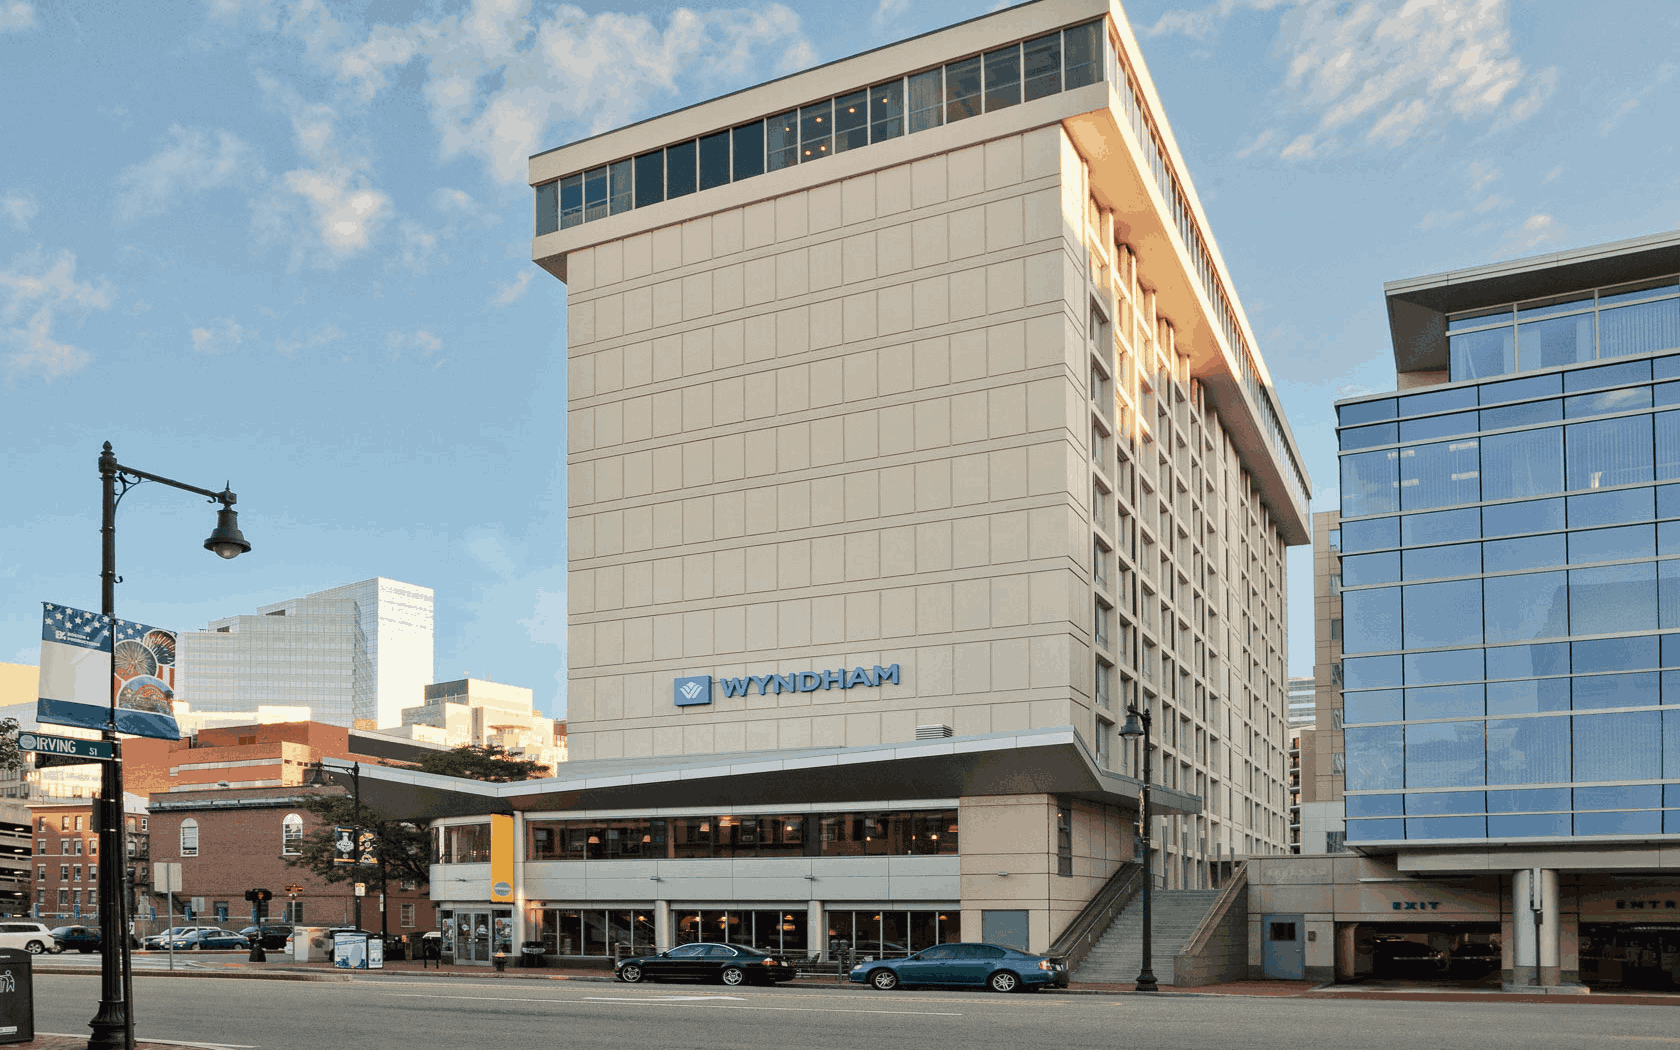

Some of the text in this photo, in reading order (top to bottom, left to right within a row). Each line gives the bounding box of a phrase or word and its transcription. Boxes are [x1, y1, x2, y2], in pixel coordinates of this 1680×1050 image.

[720, 664, 899, 698] WYNDHAM
[36, 736, 97, 756] IRVING ST
[1392, 901, 1440, 910] EXIT
